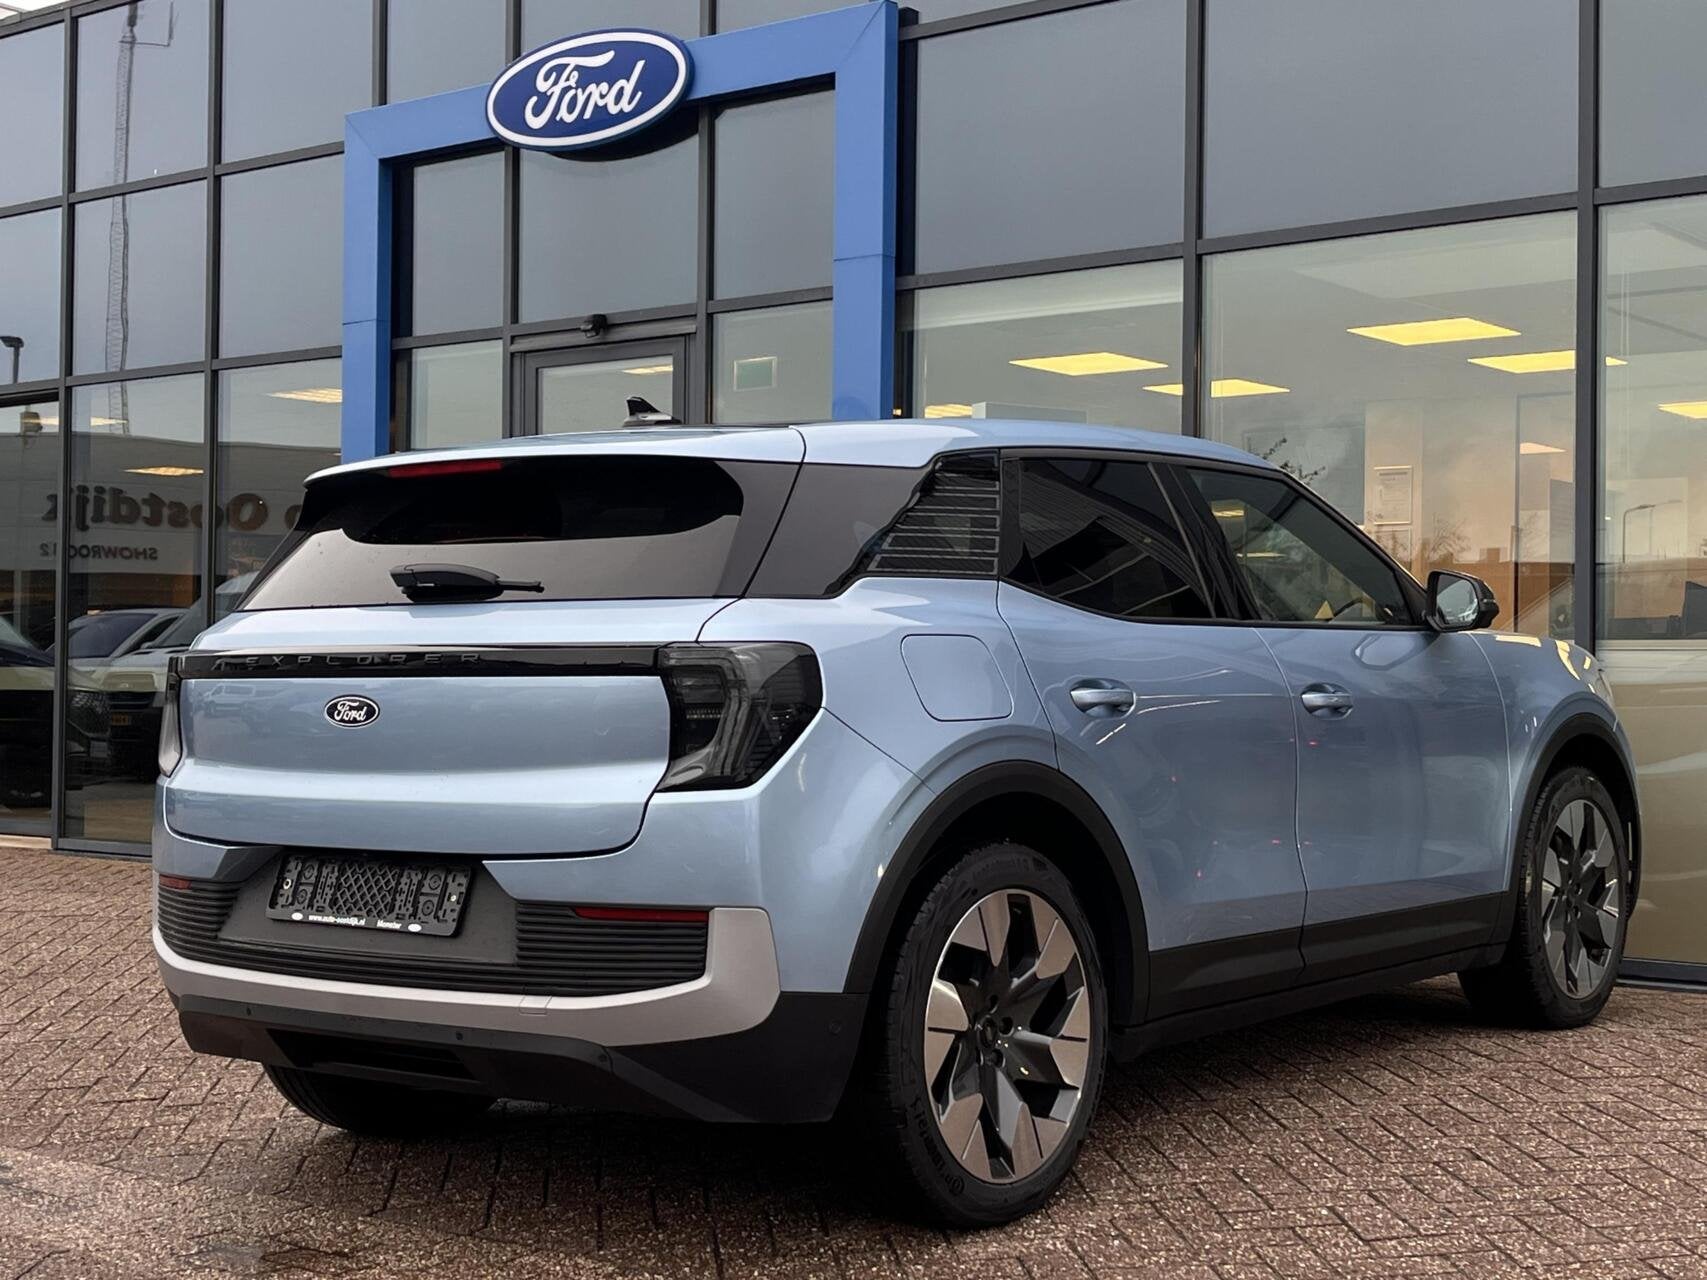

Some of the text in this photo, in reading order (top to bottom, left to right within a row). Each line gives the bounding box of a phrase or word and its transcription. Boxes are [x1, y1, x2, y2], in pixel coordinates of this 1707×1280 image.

[525, 50, 646, 129] Ford
[245, 653, 480, 666] EXPLORER
[333, 700, 367, 722] Ford
